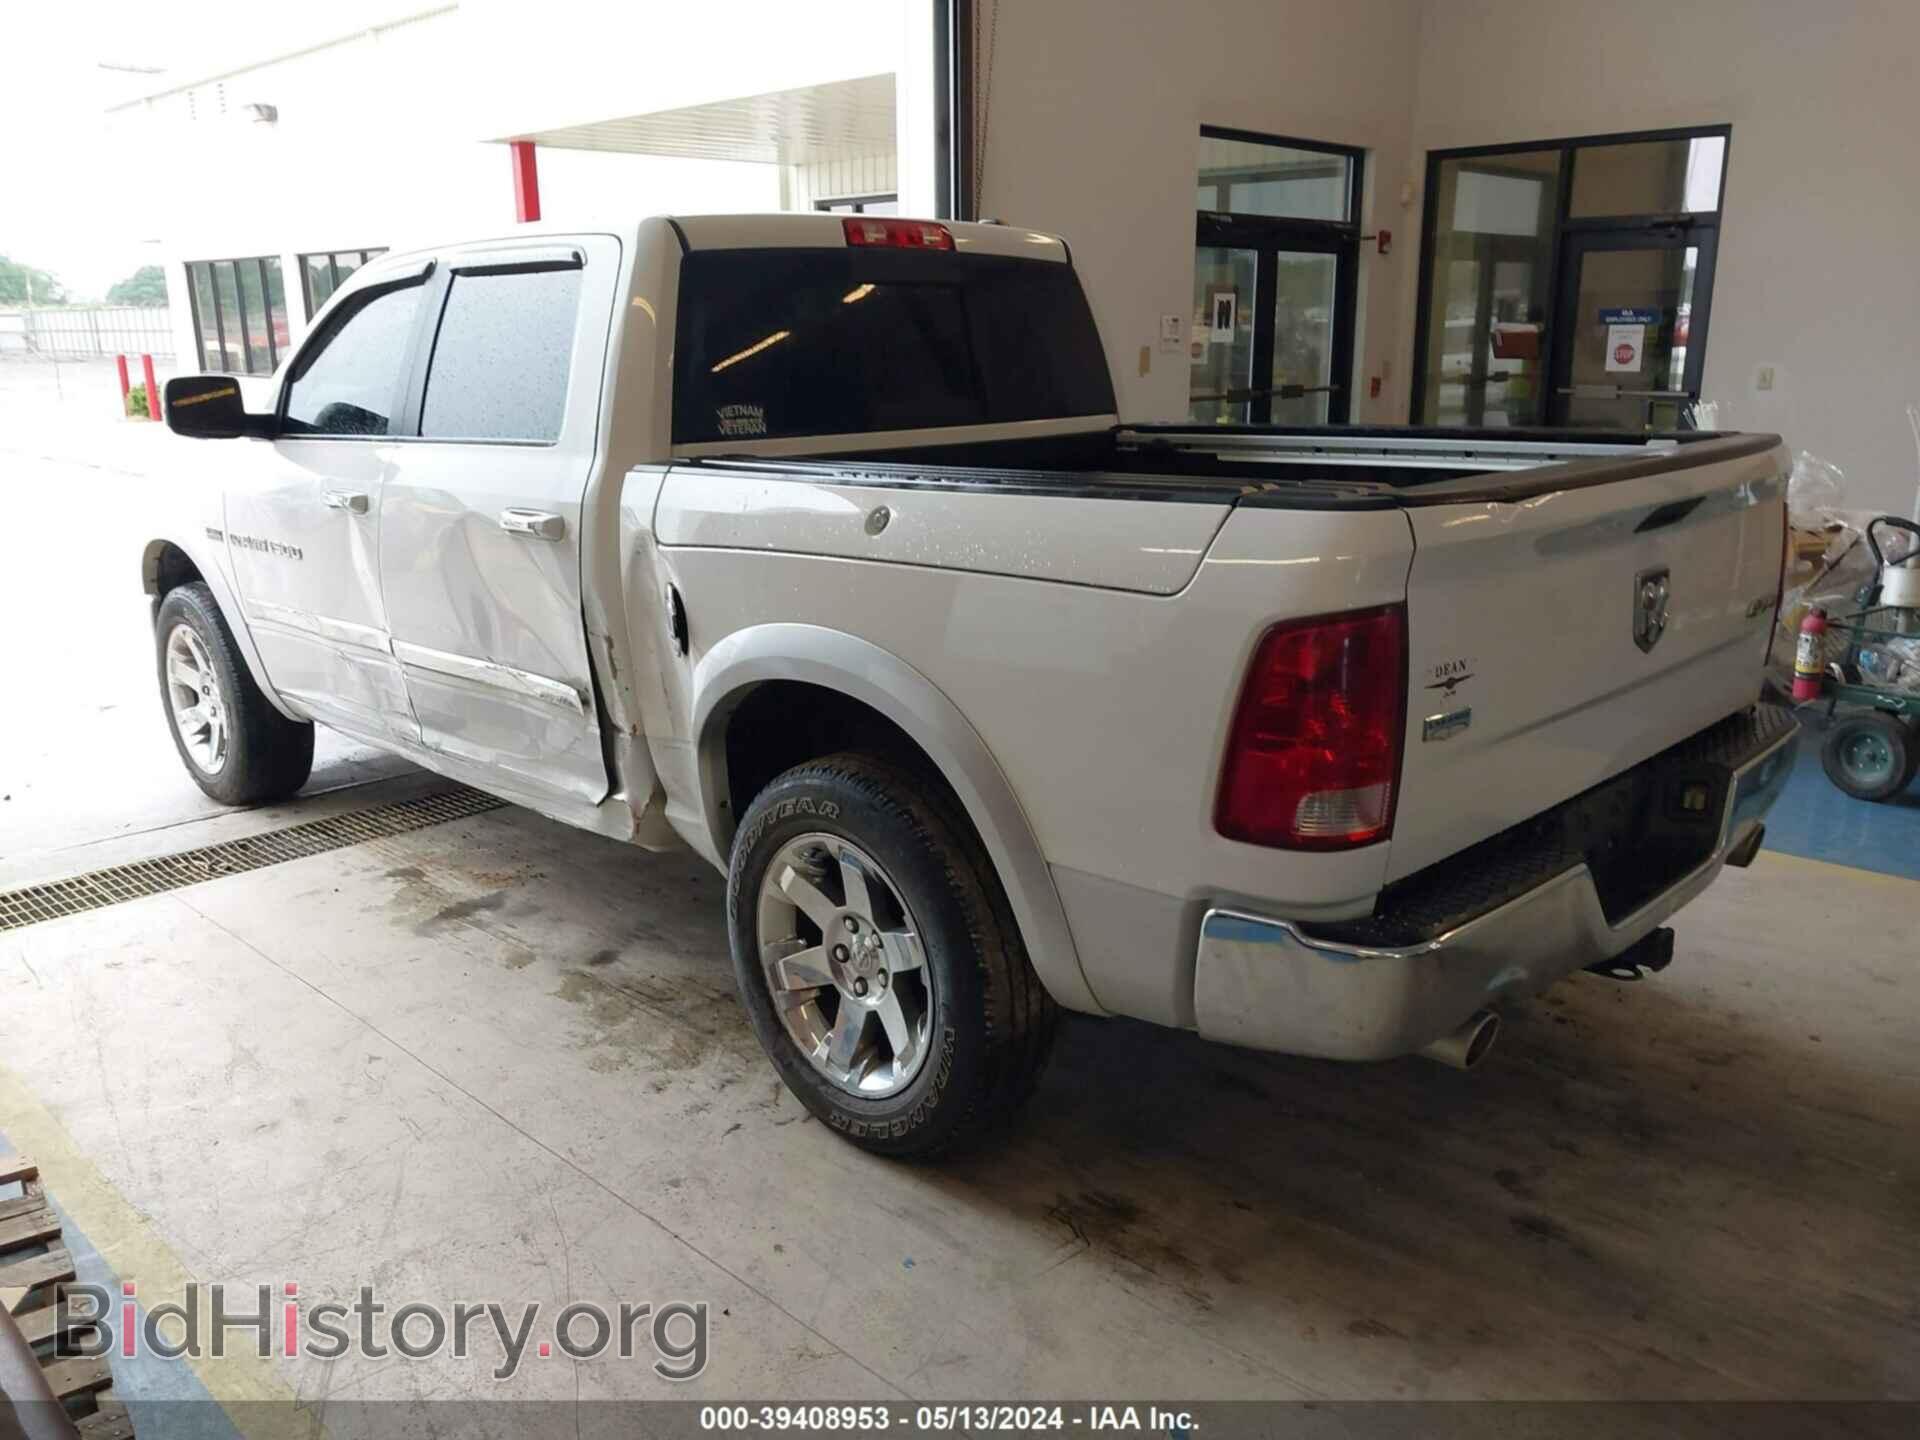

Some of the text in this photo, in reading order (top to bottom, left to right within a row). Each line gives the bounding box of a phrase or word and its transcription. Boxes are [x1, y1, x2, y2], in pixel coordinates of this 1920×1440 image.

[716, 405, 764, 419] VIETNAM
[717, 421, 767, 435] VETERAN
[1434, 659, 1466, 678] DEAN
